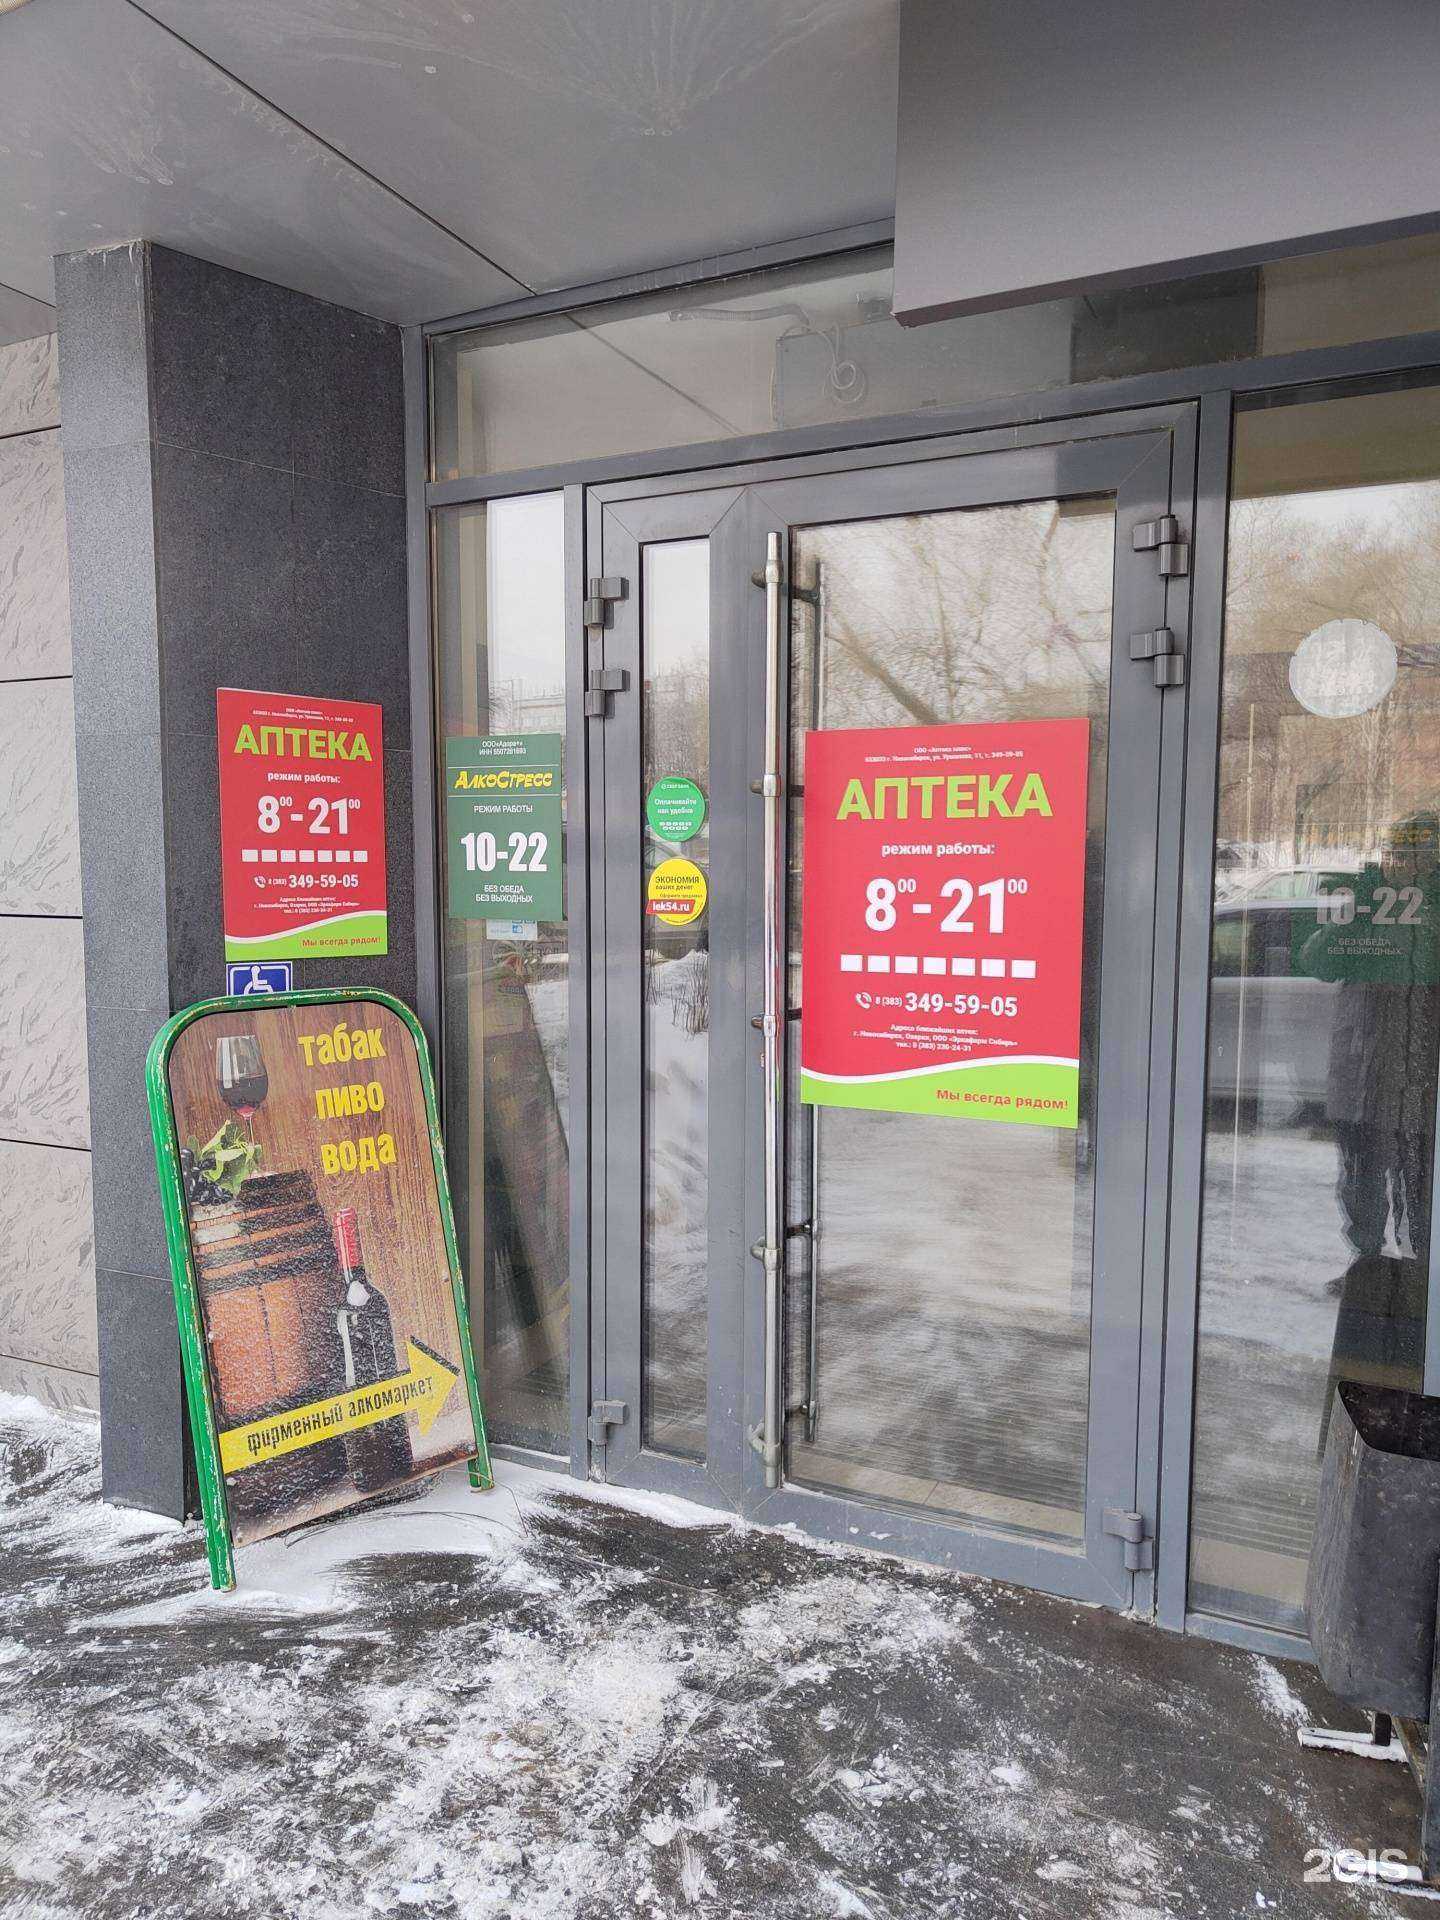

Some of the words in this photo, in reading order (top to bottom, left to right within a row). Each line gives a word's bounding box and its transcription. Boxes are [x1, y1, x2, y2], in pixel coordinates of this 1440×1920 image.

[234, 724, 373, 762] АПТЕКА
[267, 772, 302, 782] режим
[304, 773, 341, 784] работы:
[836, 773, 1053, 820] АПТЕКА
[473, 805, 502, 813] РЕЖИМ
[502, 804, 533, 813] РАБОТЫ
[460, 831, 548, 872] 10-22
[881, 843, 933, 857] режим
[936, 842, 996, 857] работы:
[288, 874, 359, 888] 349-59-05
[484, 884, 498, 893] БЕЗ
[499, 885, 525, 894] ОБЕДА
[655, 876, 700, 884] ЭКОНОМИЯ
[475, 894, 490, 902] БЕЗ
[490, 894, 533, 903] ВЫХОДНЫХ
[652, 900, 690, 912] lek54.ru
[1316, 886, 1424, 925] 10-22
[302, 938, 317, 947] Мы
[320, 938, 348, 947] всегда
[904, 991, 1018, 1017] 349-59-05
[298, 1023, 386, 1066] табак
[315, 1081, 386, 1120] пиво
[936, 1089, 960, 1100] Мы
[964, 1092, 1011, 1106] всегда
[1016, 1096, 1068, 1110] рядом!
[320, 1133, 397, 1175] вода
[247, 1402, 344, 1456] фирменный
[349, 1376, 433, 1417] алкомаркет
